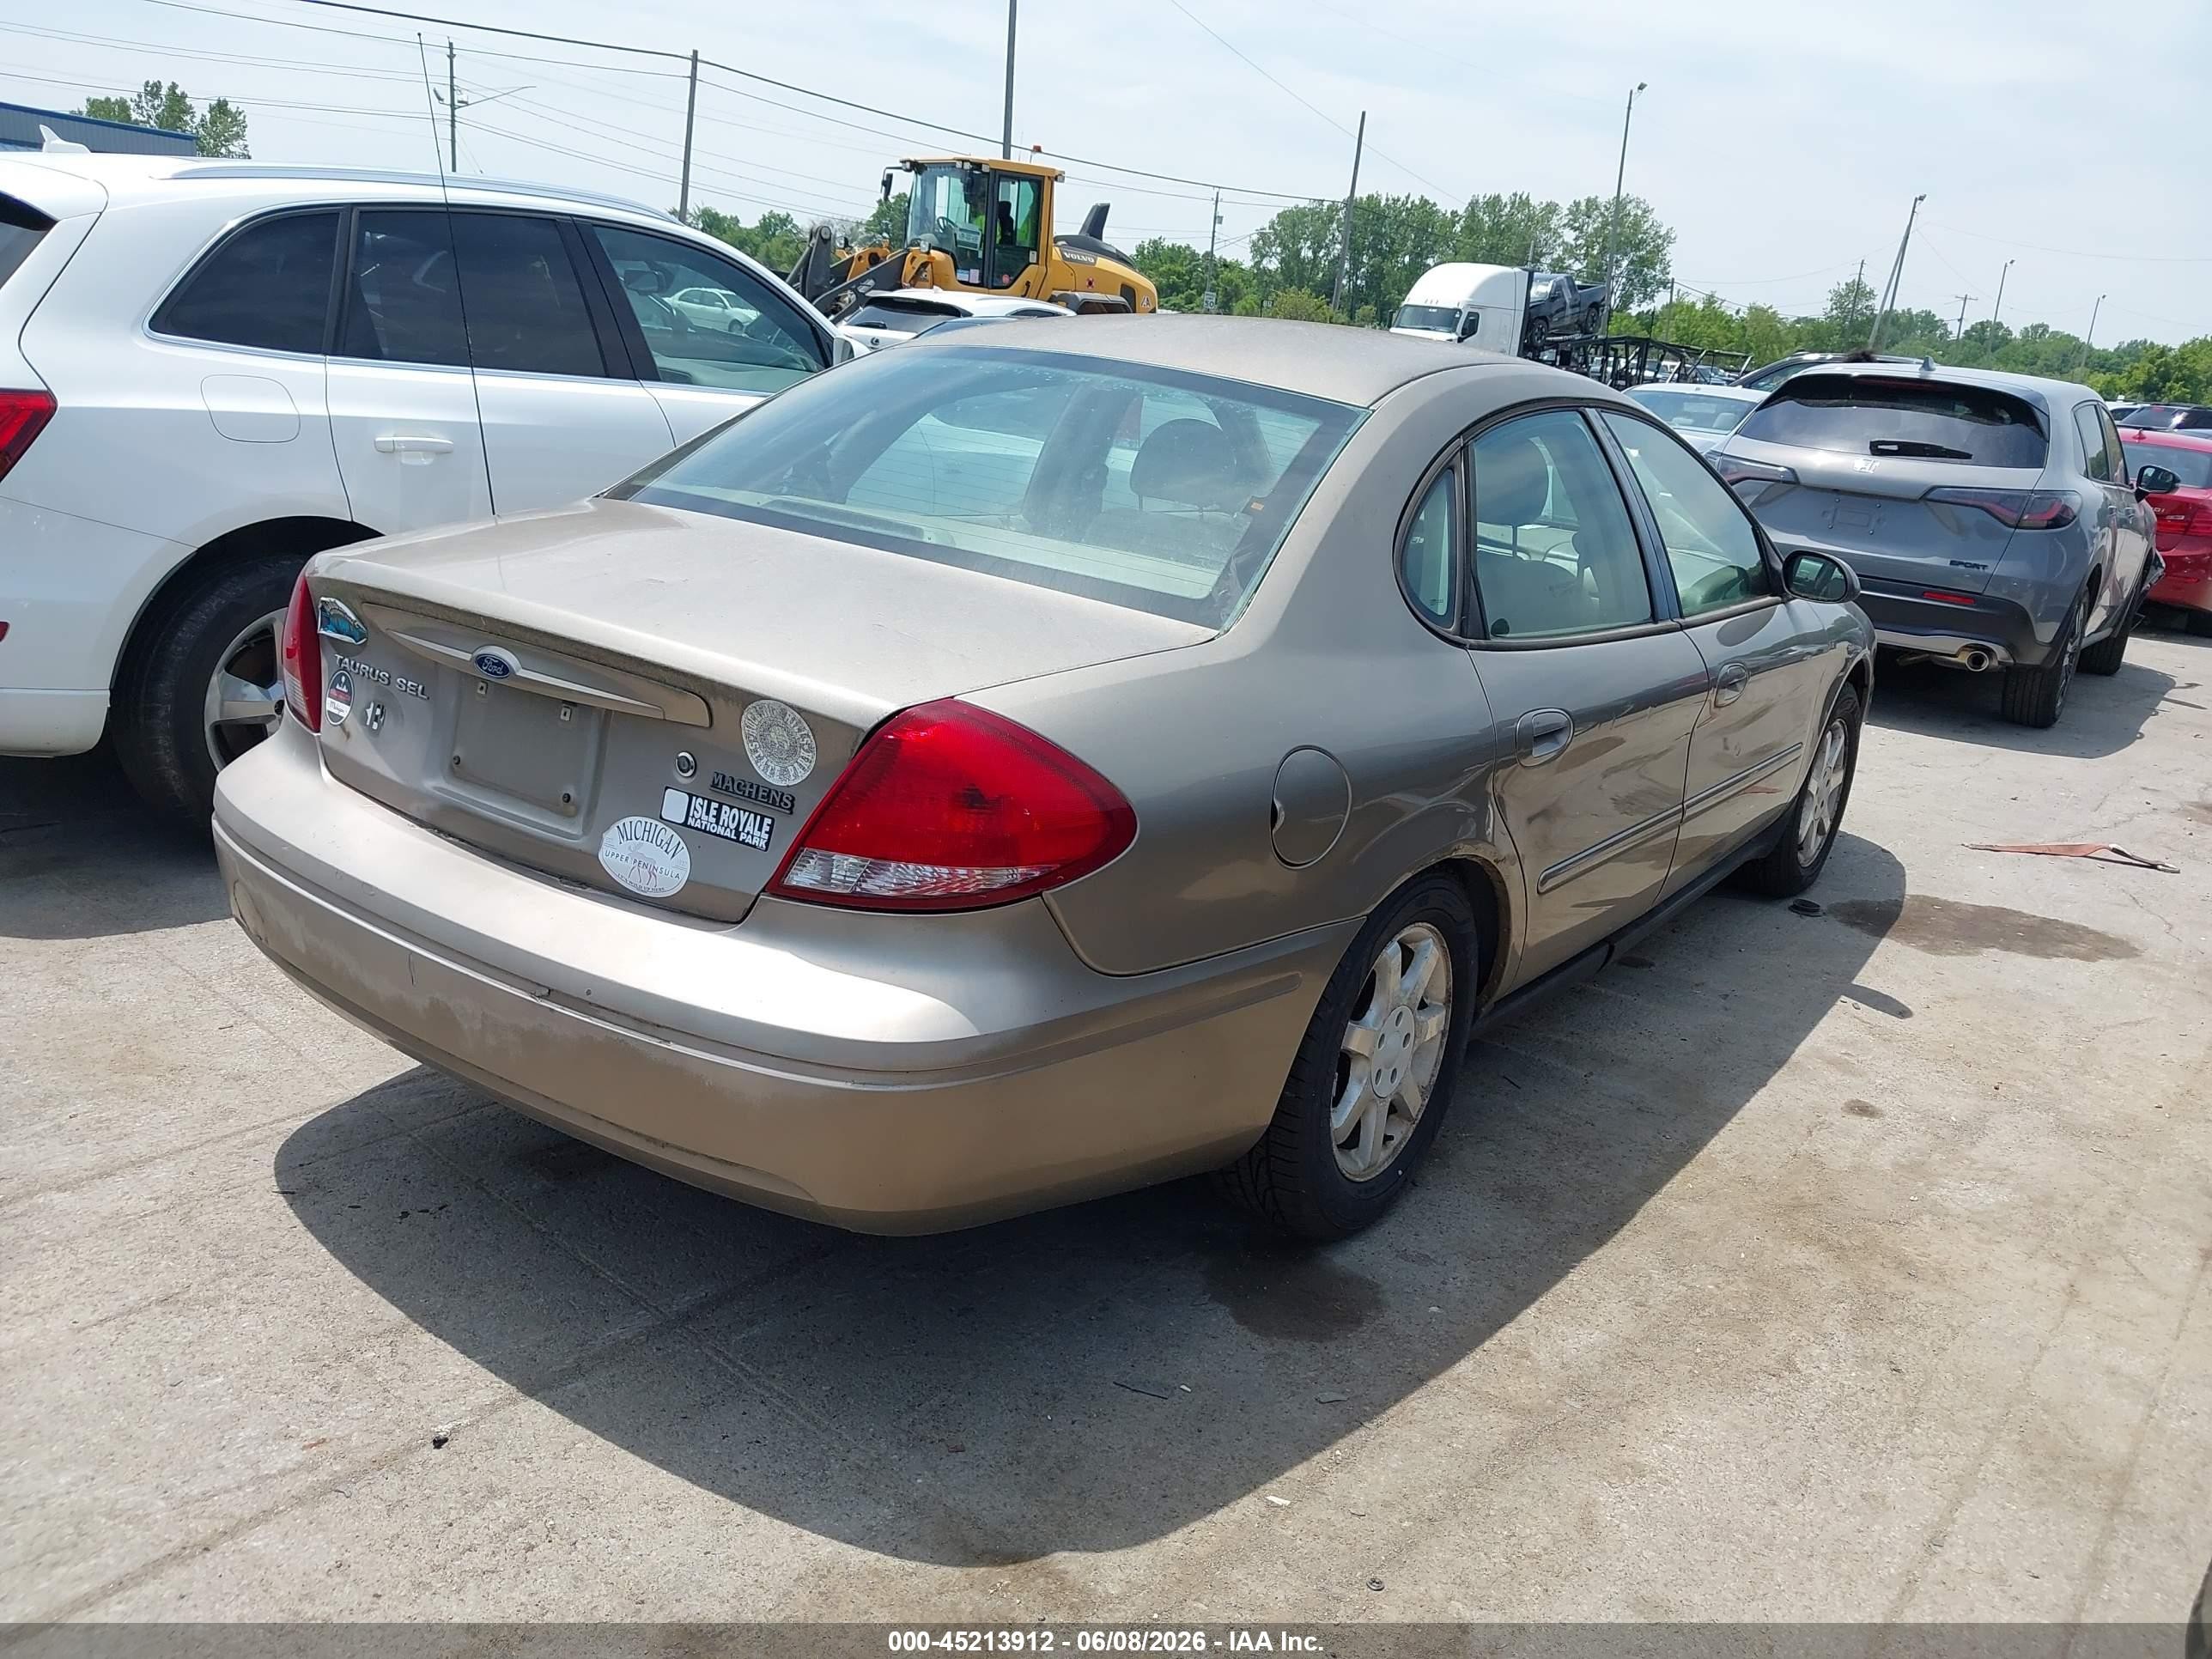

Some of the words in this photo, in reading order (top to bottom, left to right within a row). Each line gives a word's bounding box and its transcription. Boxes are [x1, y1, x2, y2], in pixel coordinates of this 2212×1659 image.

[1064, 252, 1095, 263] VOLVO
[1204, 300, 1214, 308] 50
[1949, 560, 1989, 570] SPORT
[334, 653, 392, 685] TAURUS
[396, 677, 429, 700] SEL
[748, 741, 781, 778] STATE
[787, 749, 812, 780] PARK
[711, 771, 795, 810] MACHENS
[687, 817, 738, 840] NATIONAL
[738, 831, 769, 849] PARK
[690, 796, 719, 823] ISLE
[719, 805, 772, 840] ROYALE
[617, 820, 684, 860] MICHIGAN
[605, 850, 629, 864] UPPER
[632, 859, 681, 880] PENINSULA
